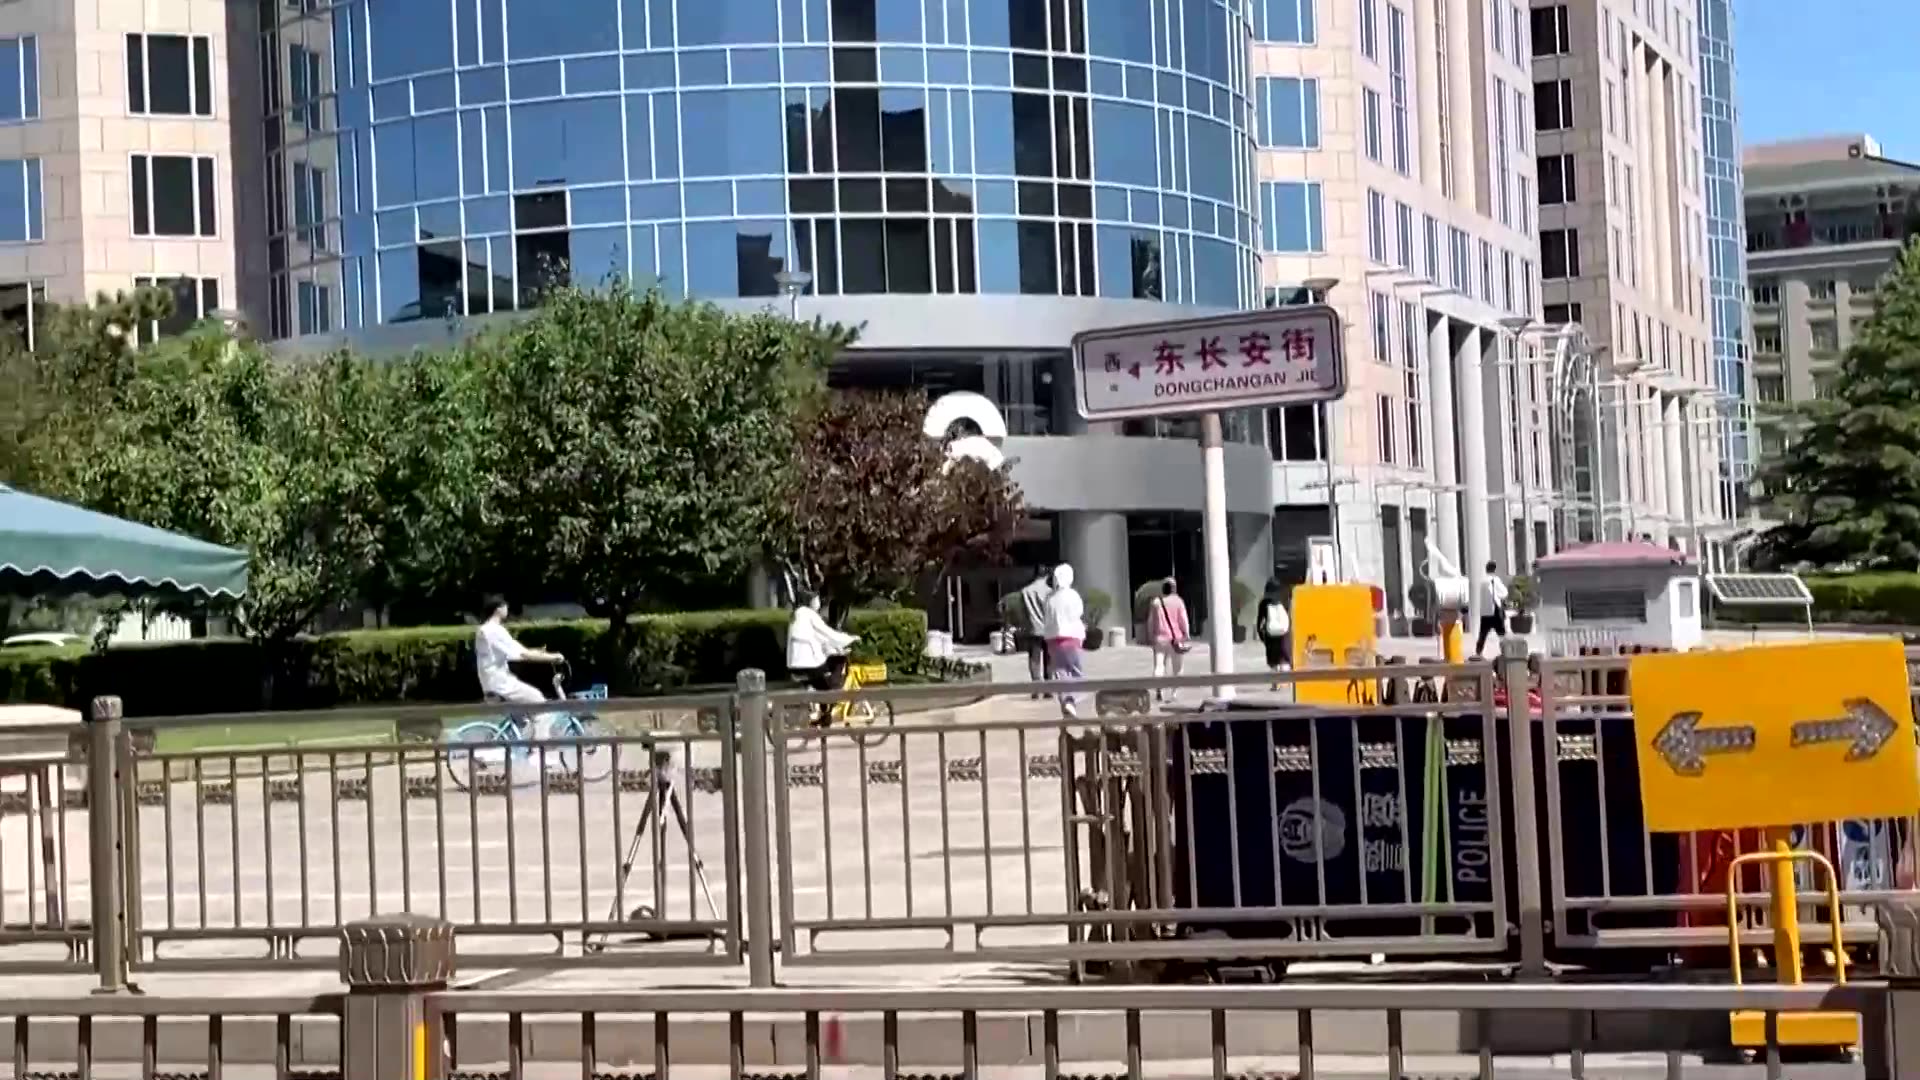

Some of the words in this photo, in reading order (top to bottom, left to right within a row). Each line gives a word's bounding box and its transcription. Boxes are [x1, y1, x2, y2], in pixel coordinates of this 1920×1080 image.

[1104, 351, 1121, 373] 西
[1153, 327, 1315, 375] 东长安街
[1154, 371, 1286, 397] DONGCHANGAN
[1457, 788, 1488, 882] POLICE
